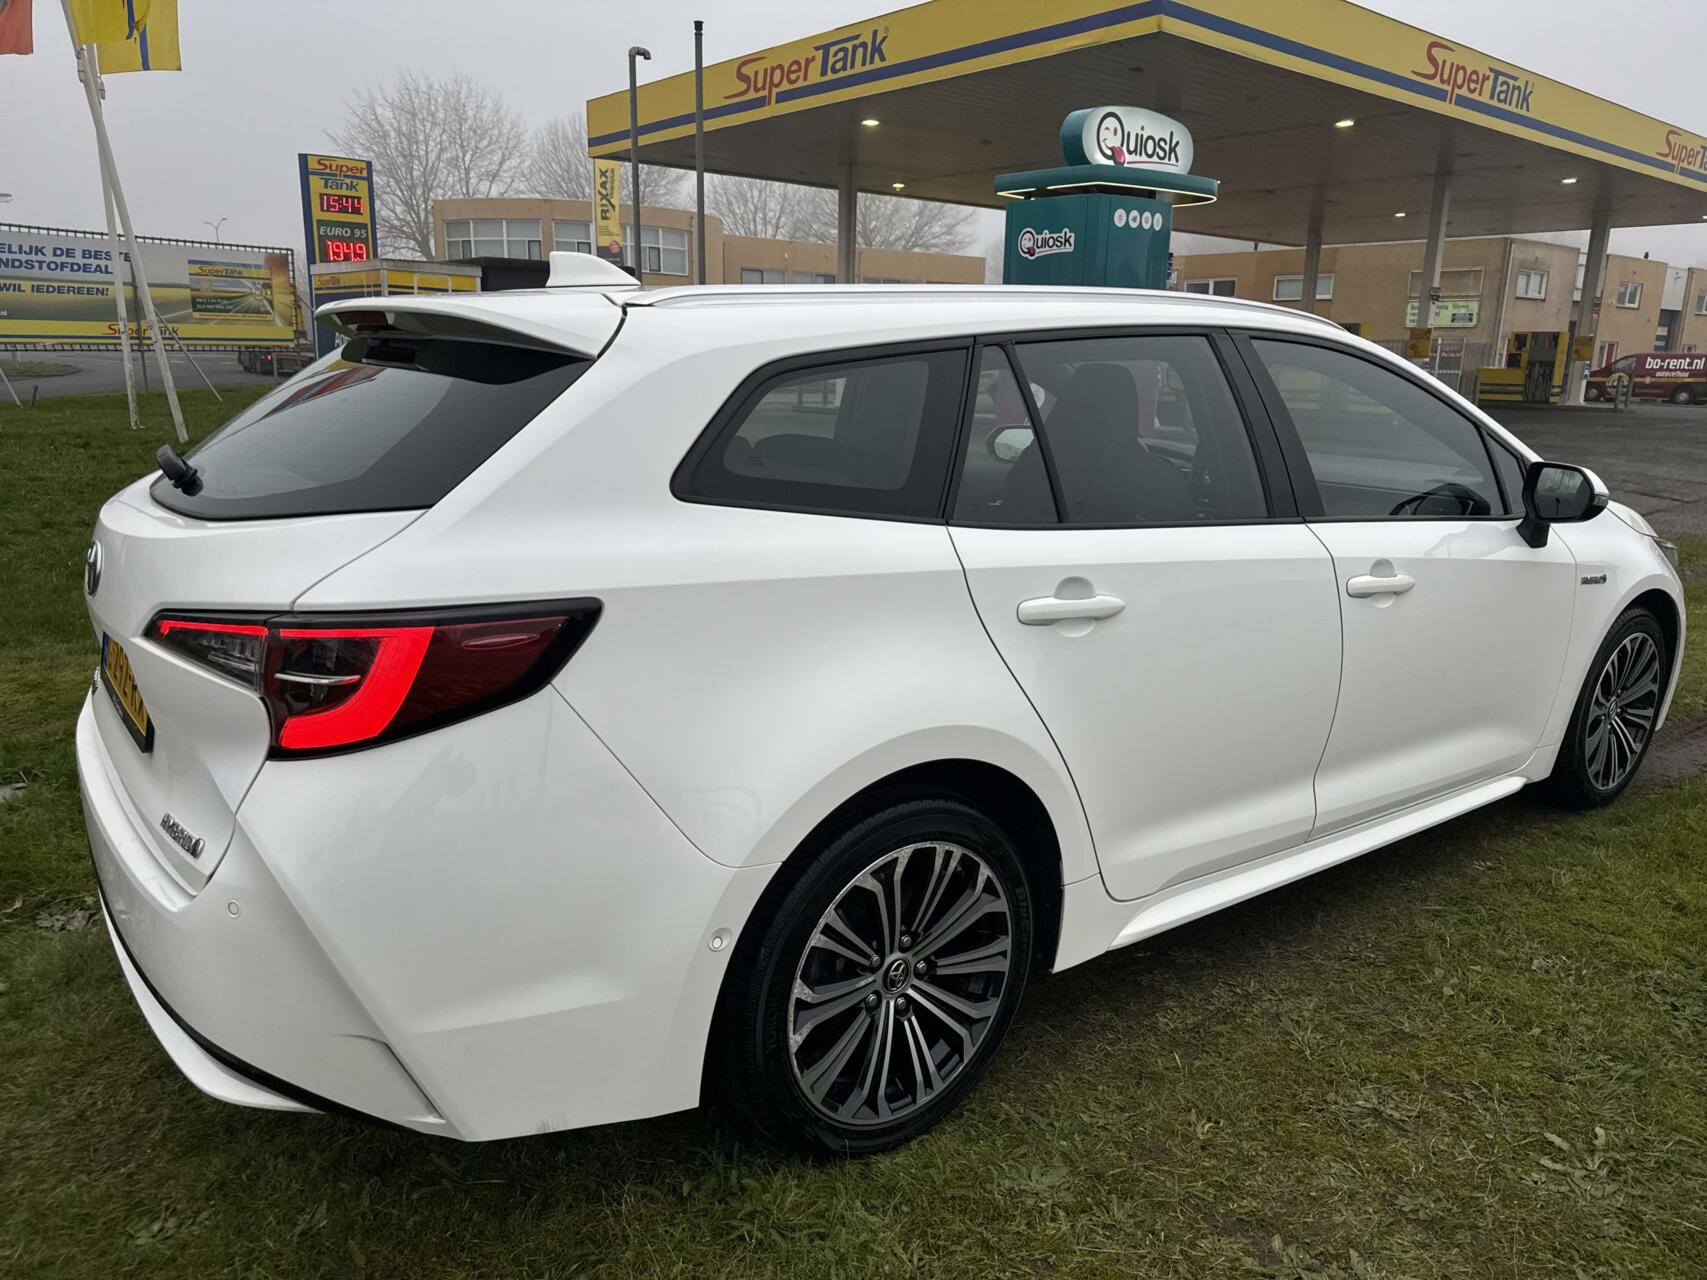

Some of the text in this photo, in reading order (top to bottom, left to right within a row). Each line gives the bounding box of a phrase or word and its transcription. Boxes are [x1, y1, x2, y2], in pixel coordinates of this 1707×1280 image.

[723, 29, 888, 106] SuperTank
[1410, 40, 1534, 113] SuperTank
[1096, 111, 1180, 165] Quiosk
[310, 158, 367, 177] Super
[318, 177, 359, 192] Tank
[323, 195, 365, 213] 15:44
[320, 226, 367, 238] EURO 95
[1019, 229, 1073, 256] Quiosk
[52, 247, 76, 258] DE
[31, 284, 109, 296] IEDEREEN!
[1645, 357, 1706, 370] bo-rent.nl
